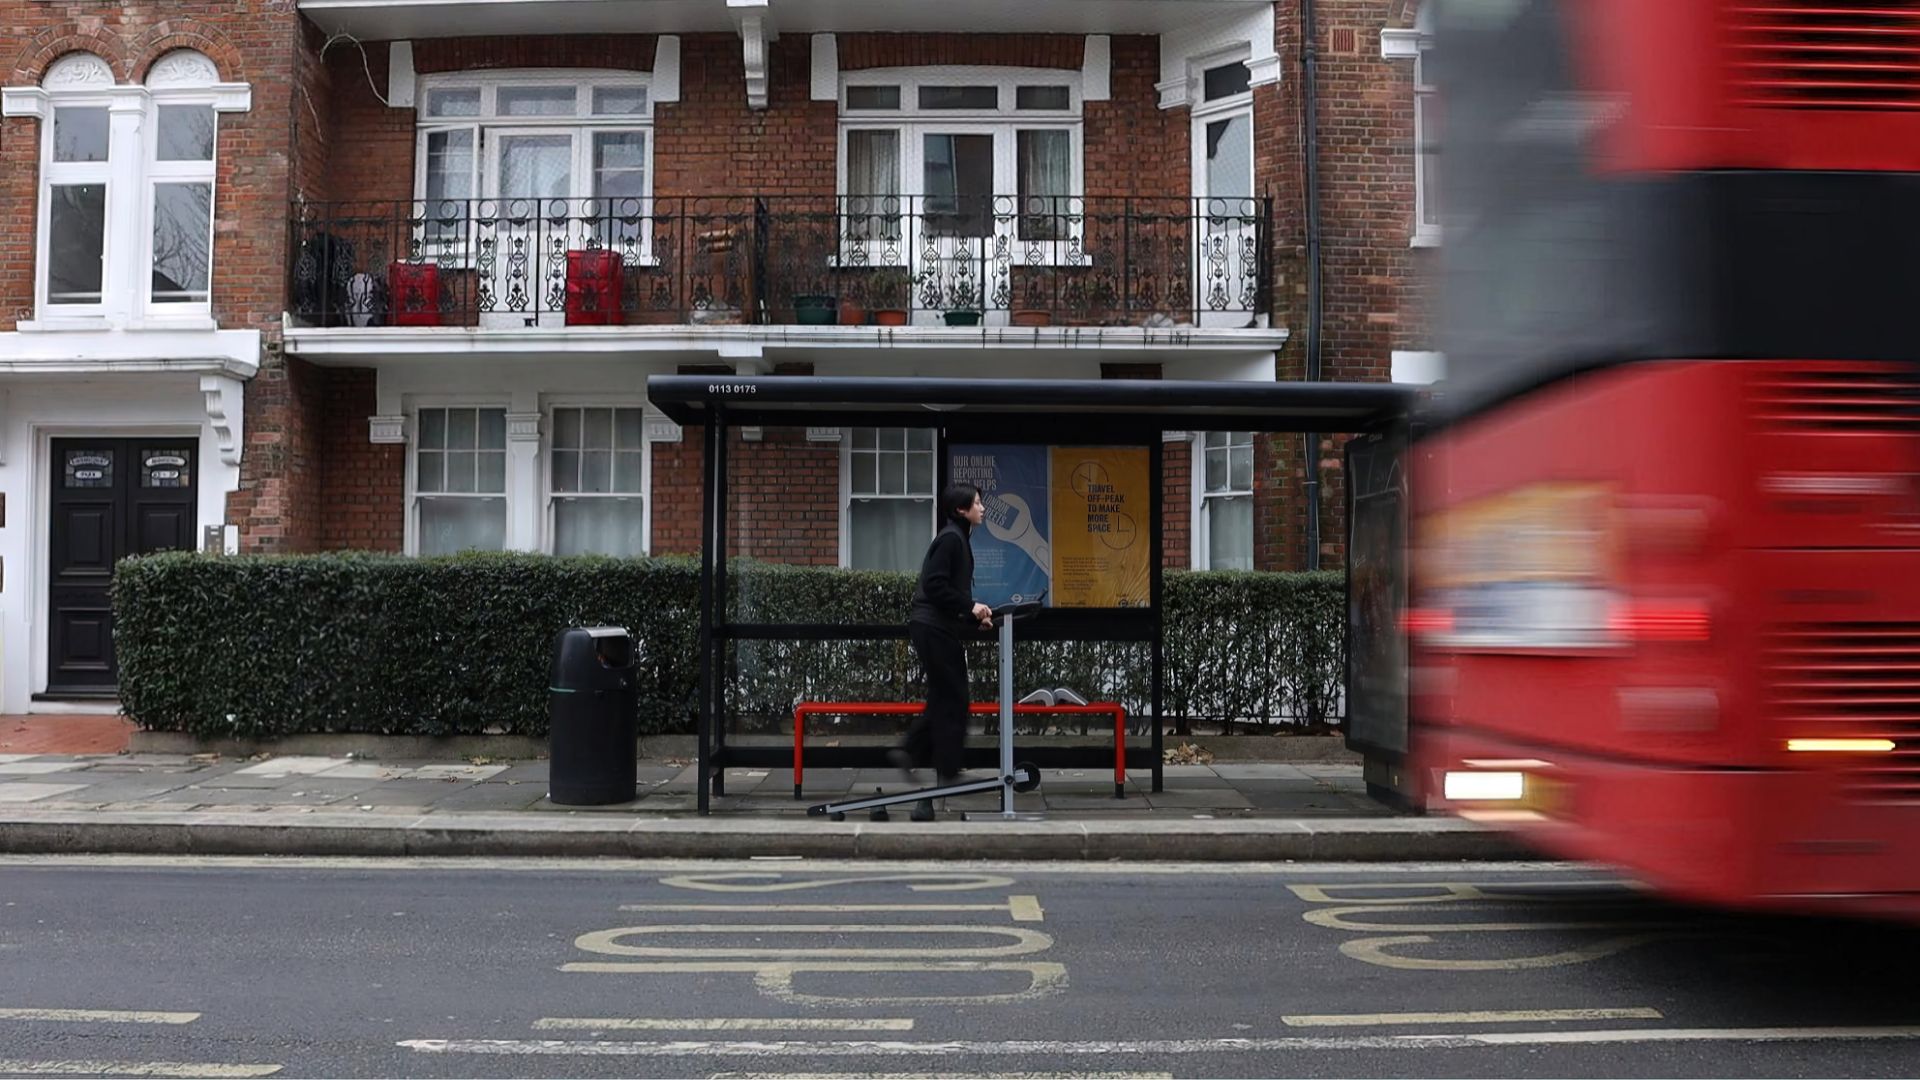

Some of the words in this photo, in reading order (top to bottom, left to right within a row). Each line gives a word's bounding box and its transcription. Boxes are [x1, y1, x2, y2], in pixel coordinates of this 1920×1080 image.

[708, 384, 731, 393] 0113
[733, 384, 756, 393] 0175
[953, 455, 969, 467] OUR
[970, 455, 996, 467] ONLINE
[953, 467, 993, 479] REPORTING
[973, 479, 997, 491] HELPS
[1088, 484, 1115, 493] TRAVEL
[1088, 494, 1125, 503] OFF-PEAK
[982, 493, 1010, 514] LONDON
[1088, 504, 1097, 513] TO
[1099, 504, 1121, 513] MAKE
[1088, 514, 1109, 522] MORE
[1088, 524, 1111, 533] SPACE
[557, 873, 1068, 1007] STOP
